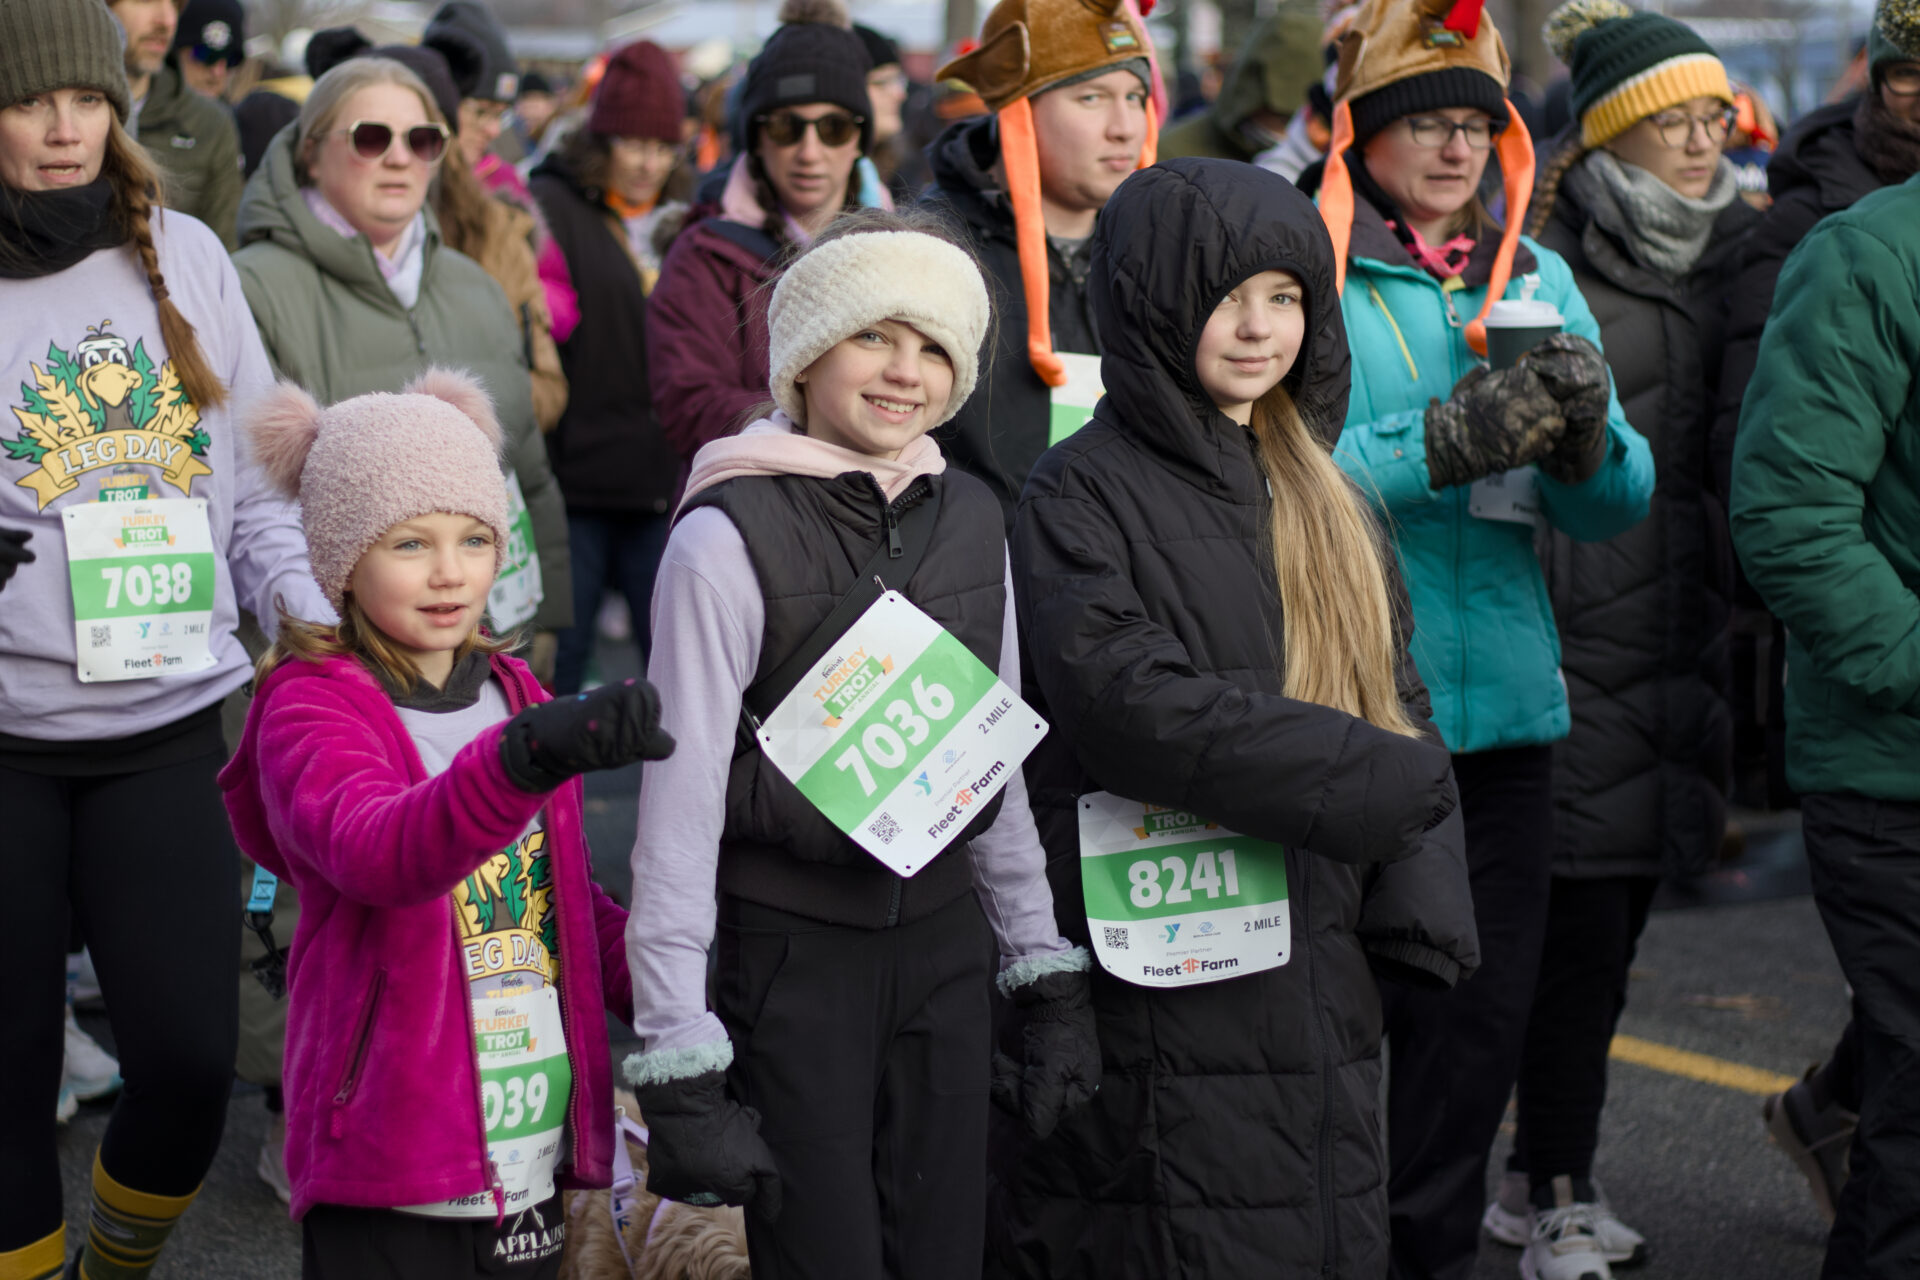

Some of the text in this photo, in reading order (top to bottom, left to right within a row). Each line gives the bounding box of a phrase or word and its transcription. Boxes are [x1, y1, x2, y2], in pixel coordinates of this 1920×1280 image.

[58, 435, 183, 475] LEG DAY
[105, 488, 141, 501] TROT
[121, 514, 166, 528] TURKEY
[128, 529, 163, 542] TROT
[101, 562, 193, 609] 7038
[189, 624, 205, 634] MILE
[124, 655, 183, 669] Fleet Farm
[813, 645, 867, 702] TURKEY
[831, 664, 874, 708] TROT
[978, 697, 1013, 735] 2 MILE
[834, 673, 955, 797] 7036
[927, 804, 963, 839] Fleet
[970, 760, 1006, 795] Farm
[1128, 849, 1240, 909] 8241
[1244, 916, 1281, 933] 2 MILE
[511, 934, 545, 970] DAY
[1143, 964, 1182, 977] Fleet
[1201, 958, 1239, 972] Farm
[475, 1014, 529, 1032] TURKEY
[484, 1031, 525, 1050] TROT
[537, 1148, 542, 1160] 2
[504, 1188, 529, 1203] Farm
[507, 1250, 537, 1263] DANCE
